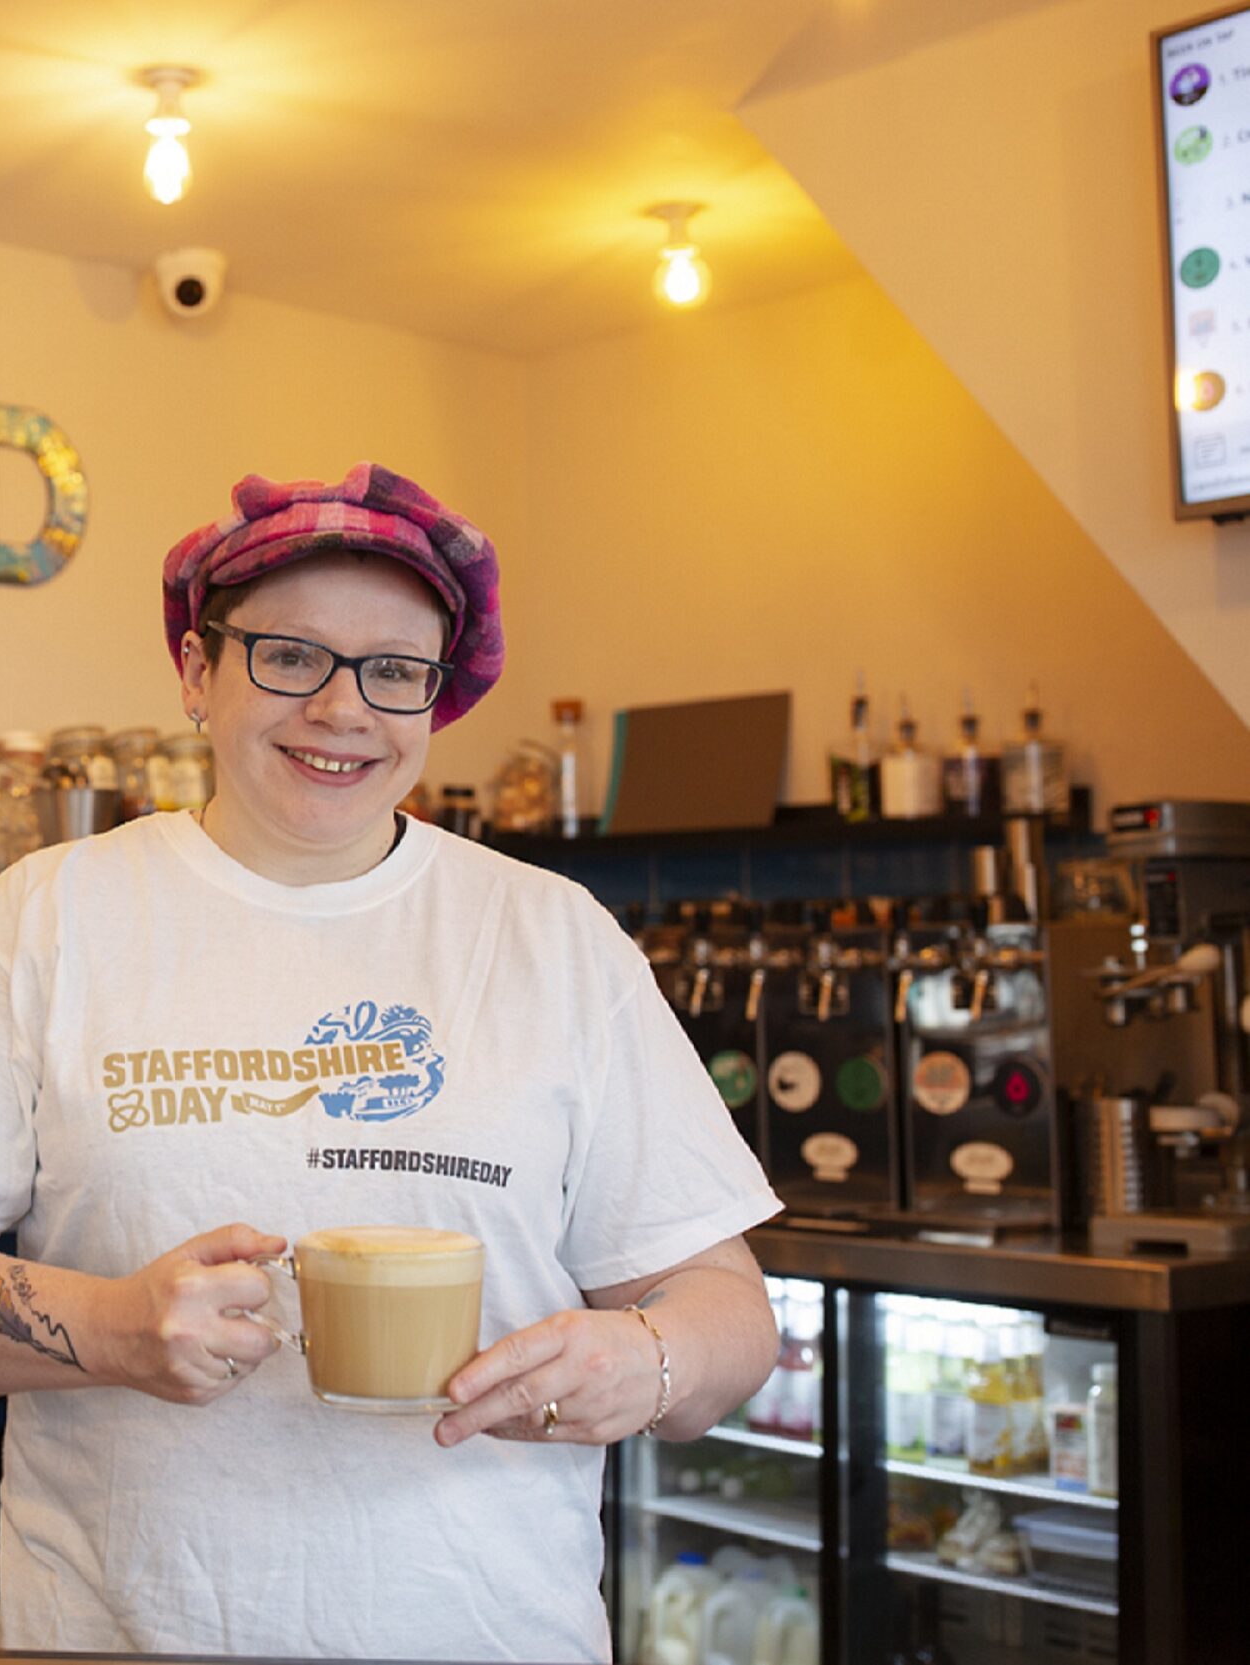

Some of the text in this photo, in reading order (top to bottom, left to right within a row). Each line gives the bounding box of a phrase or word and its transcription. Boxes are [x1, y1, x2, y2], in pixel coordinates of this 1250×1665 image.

[102, 1042, 407, 1089] STAFFORDSHIRE
[151, 1086, 228, 1126] DAY
[306, 1148, 513, 1188] #STAFFORDSHIREDAY
